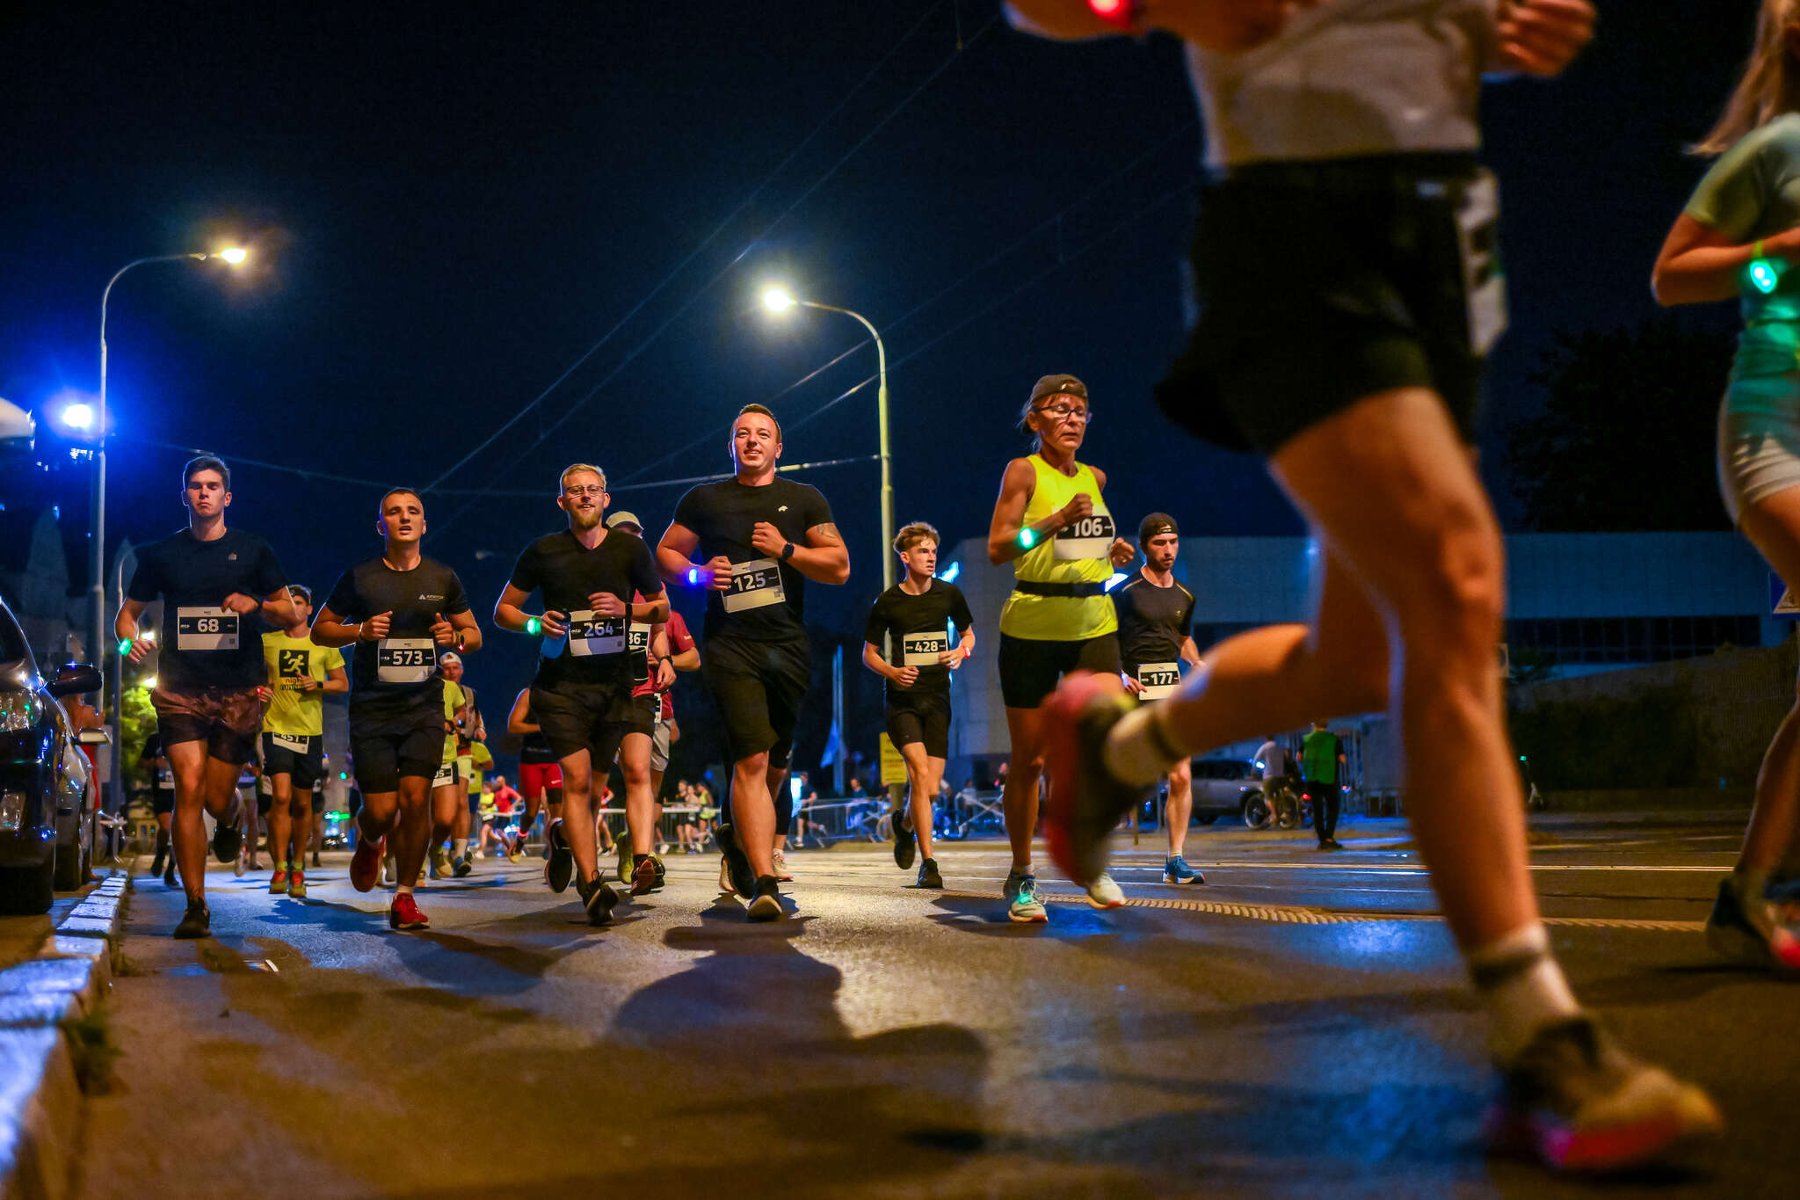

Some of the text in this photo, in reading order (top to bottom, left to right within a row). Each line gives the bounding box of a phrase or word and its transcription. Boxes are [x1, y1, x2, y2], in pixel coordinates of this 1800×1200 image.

[1072, 518, 1103, 537] 106
[734, 572, 766, 591] 125
[197, 618, 219, 632] 68
[583, 621, 613, 637] 264
[914, 641, 938, 652] 428
[393, 651, 423, 665] 573
[1150, 672, 1173, 685] 177
